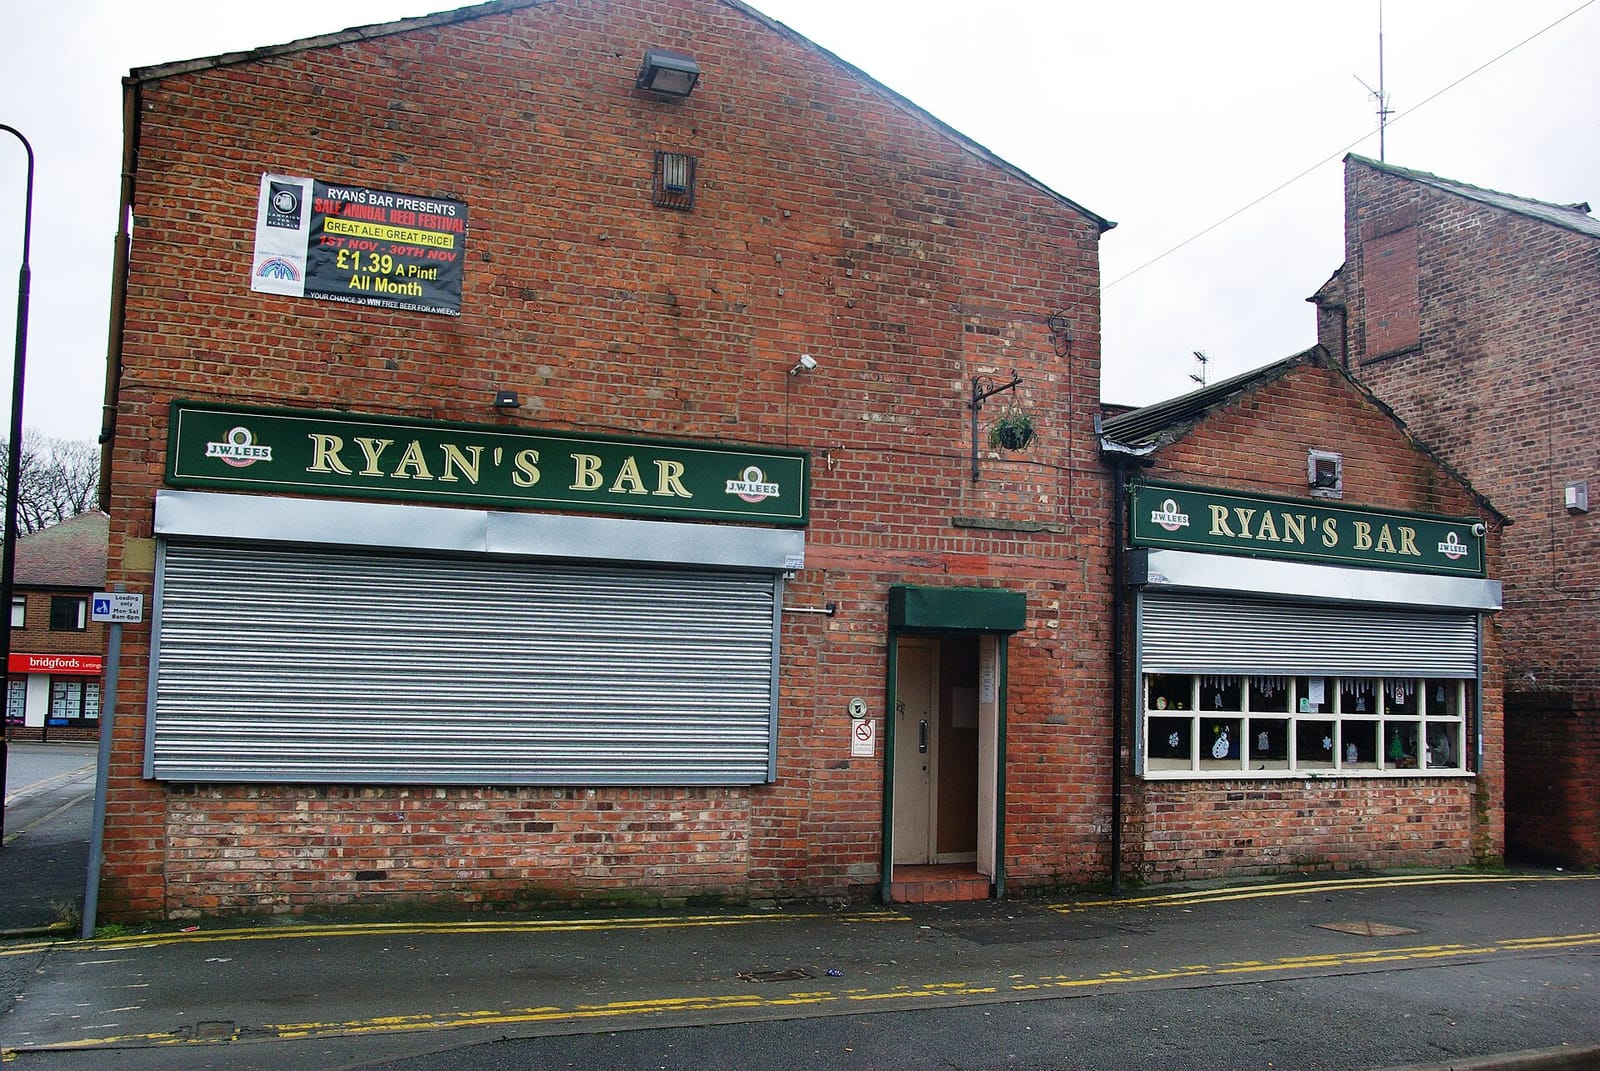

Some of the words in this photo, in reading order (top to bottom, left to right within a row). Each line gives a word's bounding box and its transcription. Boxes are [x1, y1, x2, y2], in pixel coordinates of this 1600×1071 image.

[314, 198, 340, 215] SALE
[344, 203, 386, 222] ANNUAL
[390, 210, 416, 226] BEER
[418, 213, 465, 233] FESTIVAL
[368, 194, 393, 207] BAR
[396, 198, 456, 216] PRESENTS
[326, 221, 360, 234] GREAT
[362, 226, 384, 238] ALE!
[386, 230, 418, 242] GREAT
[420, 234, 452, 246] PRICE!
[320, 236, 345, 248] 1ST
[348, 238, 380, 252] NOV
[389, 244, 426, 258] 30TH
[428, 250, 458, 262] NOV
[336, 248, 394, 274] £1.39
[394, 264, 405, 276] A
[408, 264, 438, 280] Pint!
[348, 274, 370, 290] All
[374, 276, 422, 296] Month
[310, 292, 328, 300] YOUR
[329, 294, 356, 304] CHANCE
[367, 298, 381, 306] WIN
[382, 300, 399, 309] FREE
[399, 302, 417, 311] BEER
[306, 433, 541, 488] RYAN'S
[570, 453, 693, 498] BAR
[1208, 504, 1339, 548] RYAN'S
[1353, 520, 1422, 556] BAR
[30, 657, 80, 669] bridgfords
